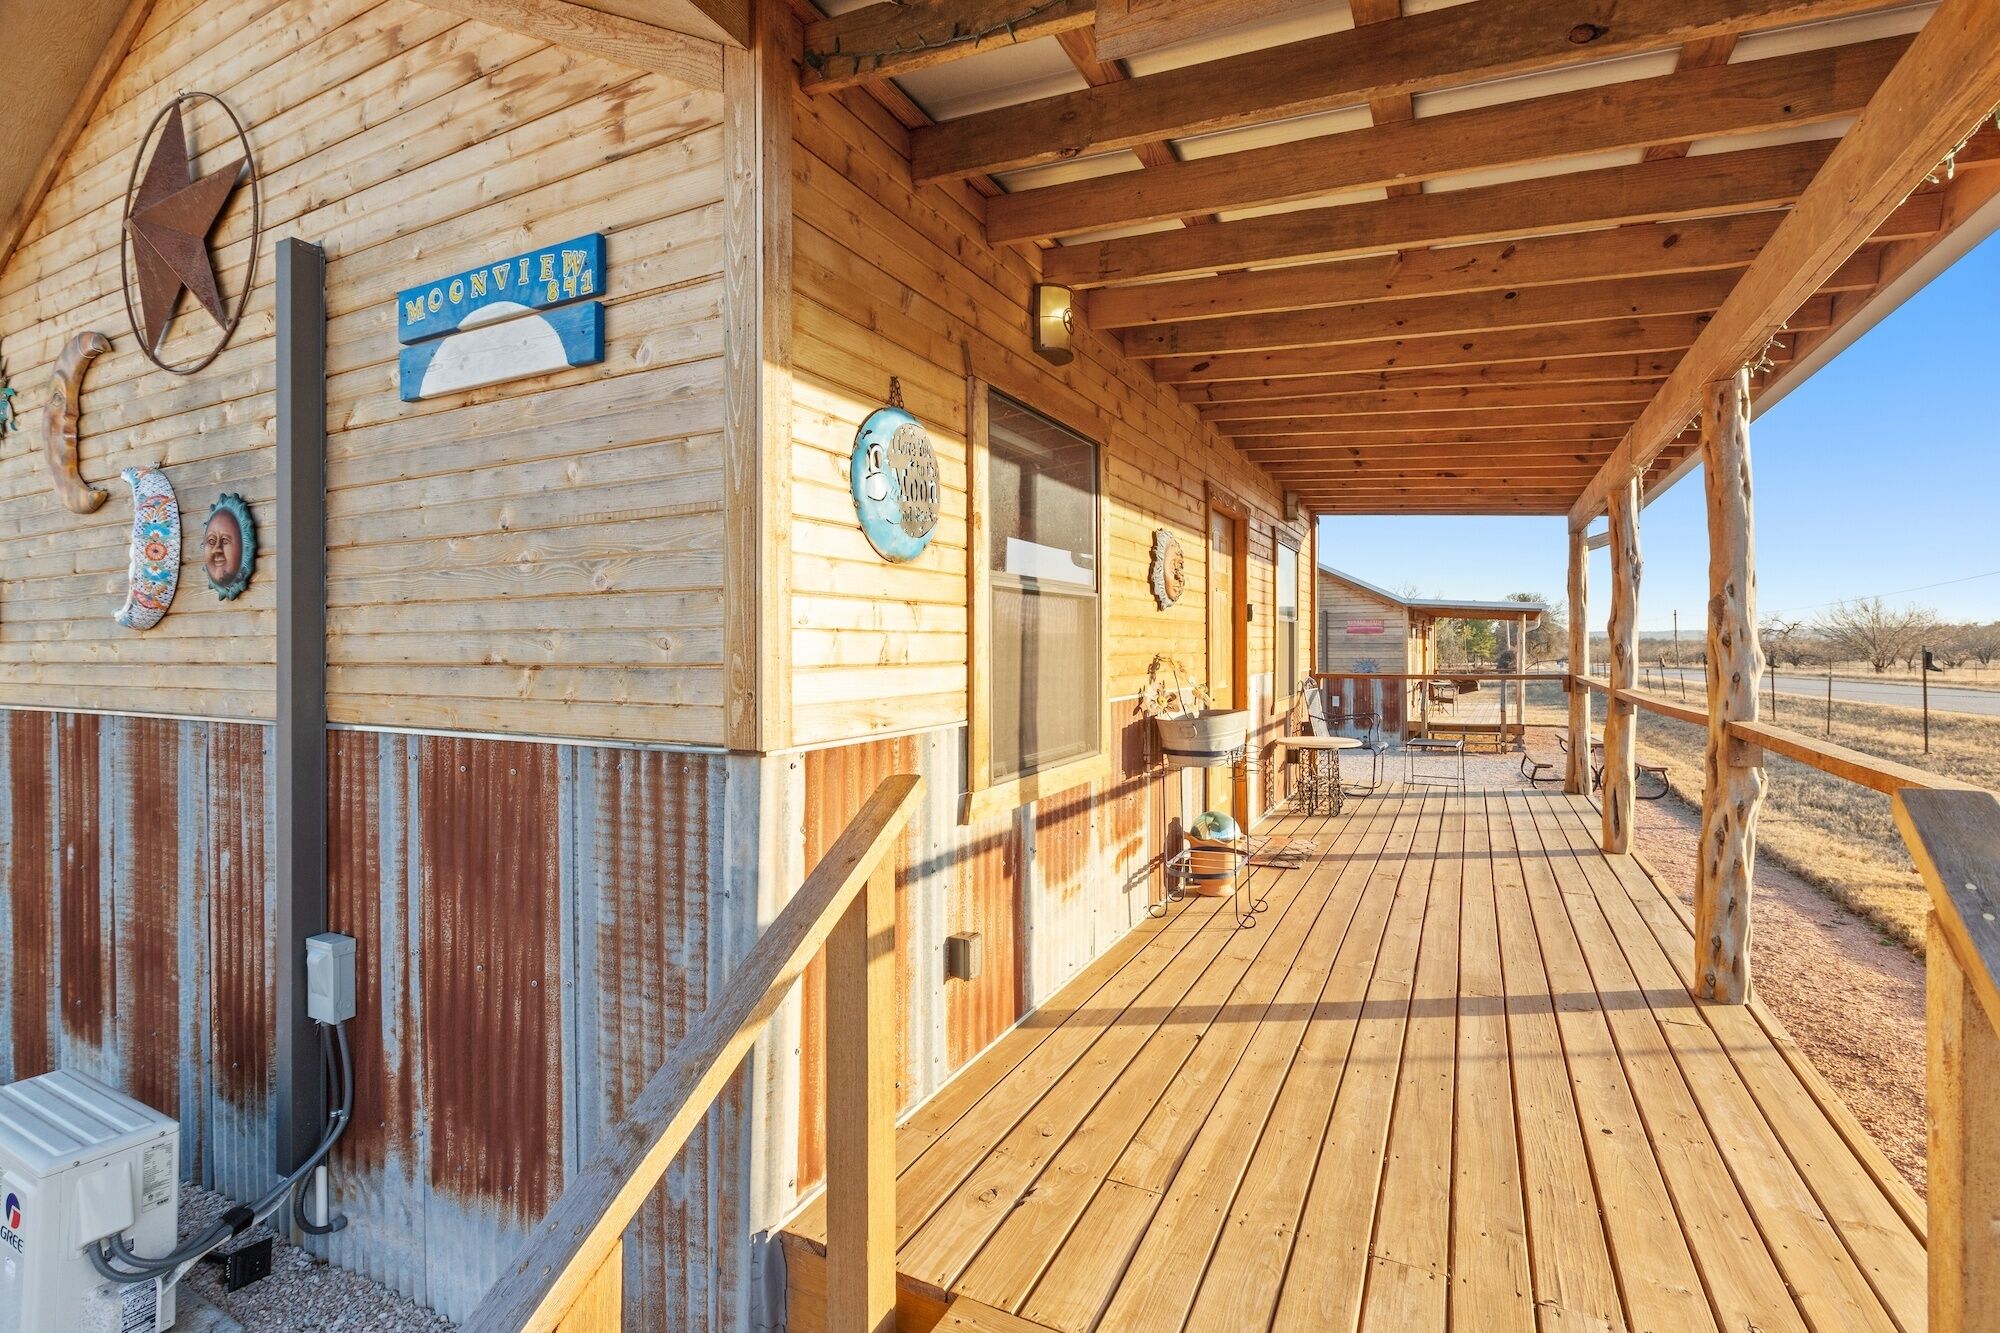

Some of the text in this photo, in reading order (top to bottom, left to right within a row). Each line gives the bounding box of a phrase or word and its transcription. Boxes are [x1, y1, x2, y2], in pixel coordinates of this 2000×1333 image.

[406, 250, 587, 325] MOONVIEW
[547, 269, 593, 302] 841
[891, 467, 938, 503] Moon
[901, 506, 913, 521] nd
[0, 1225, 24, 1254] GREE
